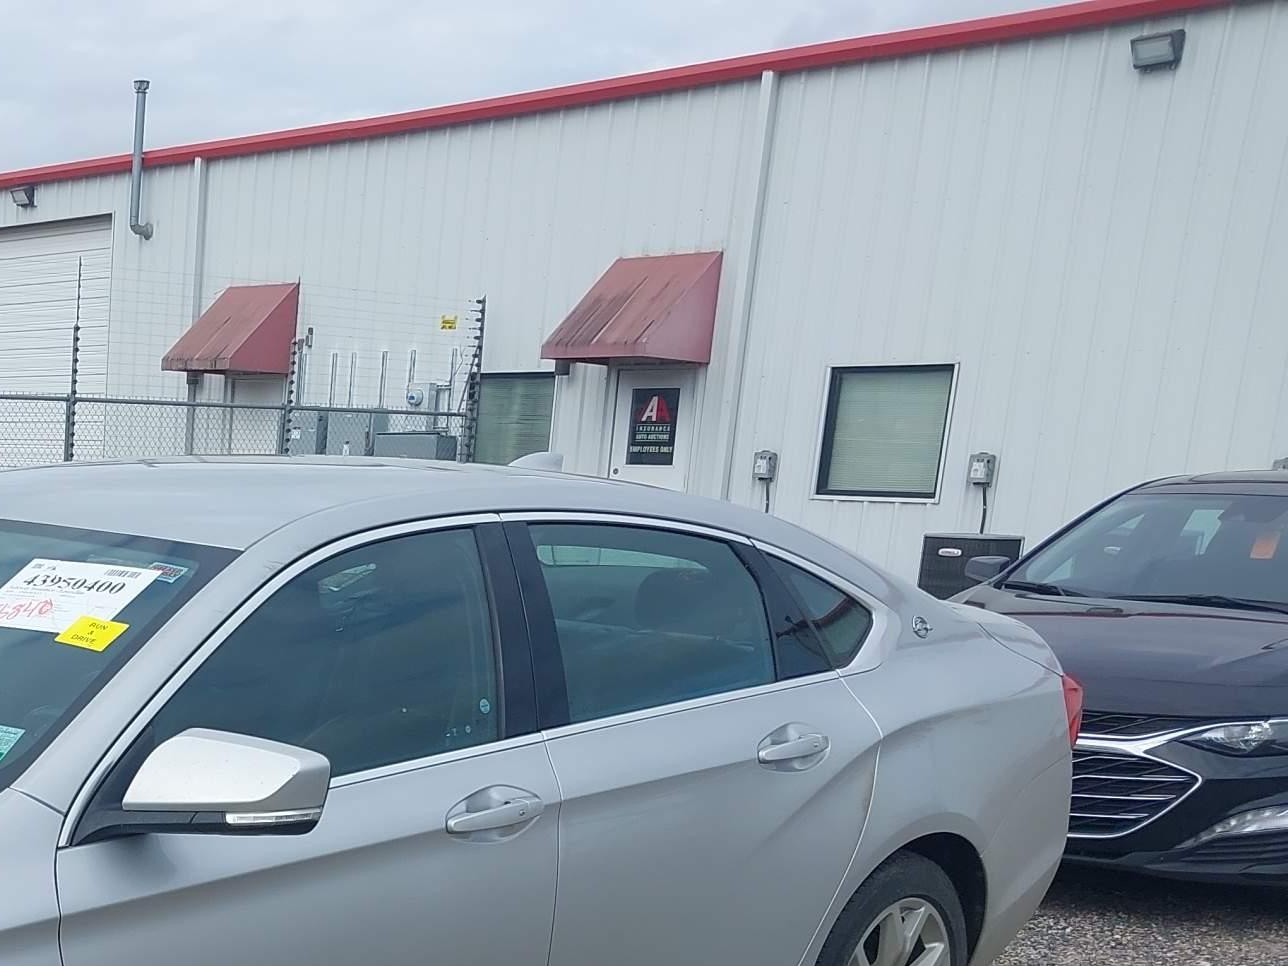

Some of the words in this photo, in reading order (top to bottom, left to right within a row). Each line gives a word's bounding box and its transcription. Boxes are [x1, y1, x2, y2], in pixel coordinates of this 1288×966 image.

[23, 574, 126, 595] 43950400
[88, 622, 109, 631] RUN
[71, 633, 97, 645] DRIVE
